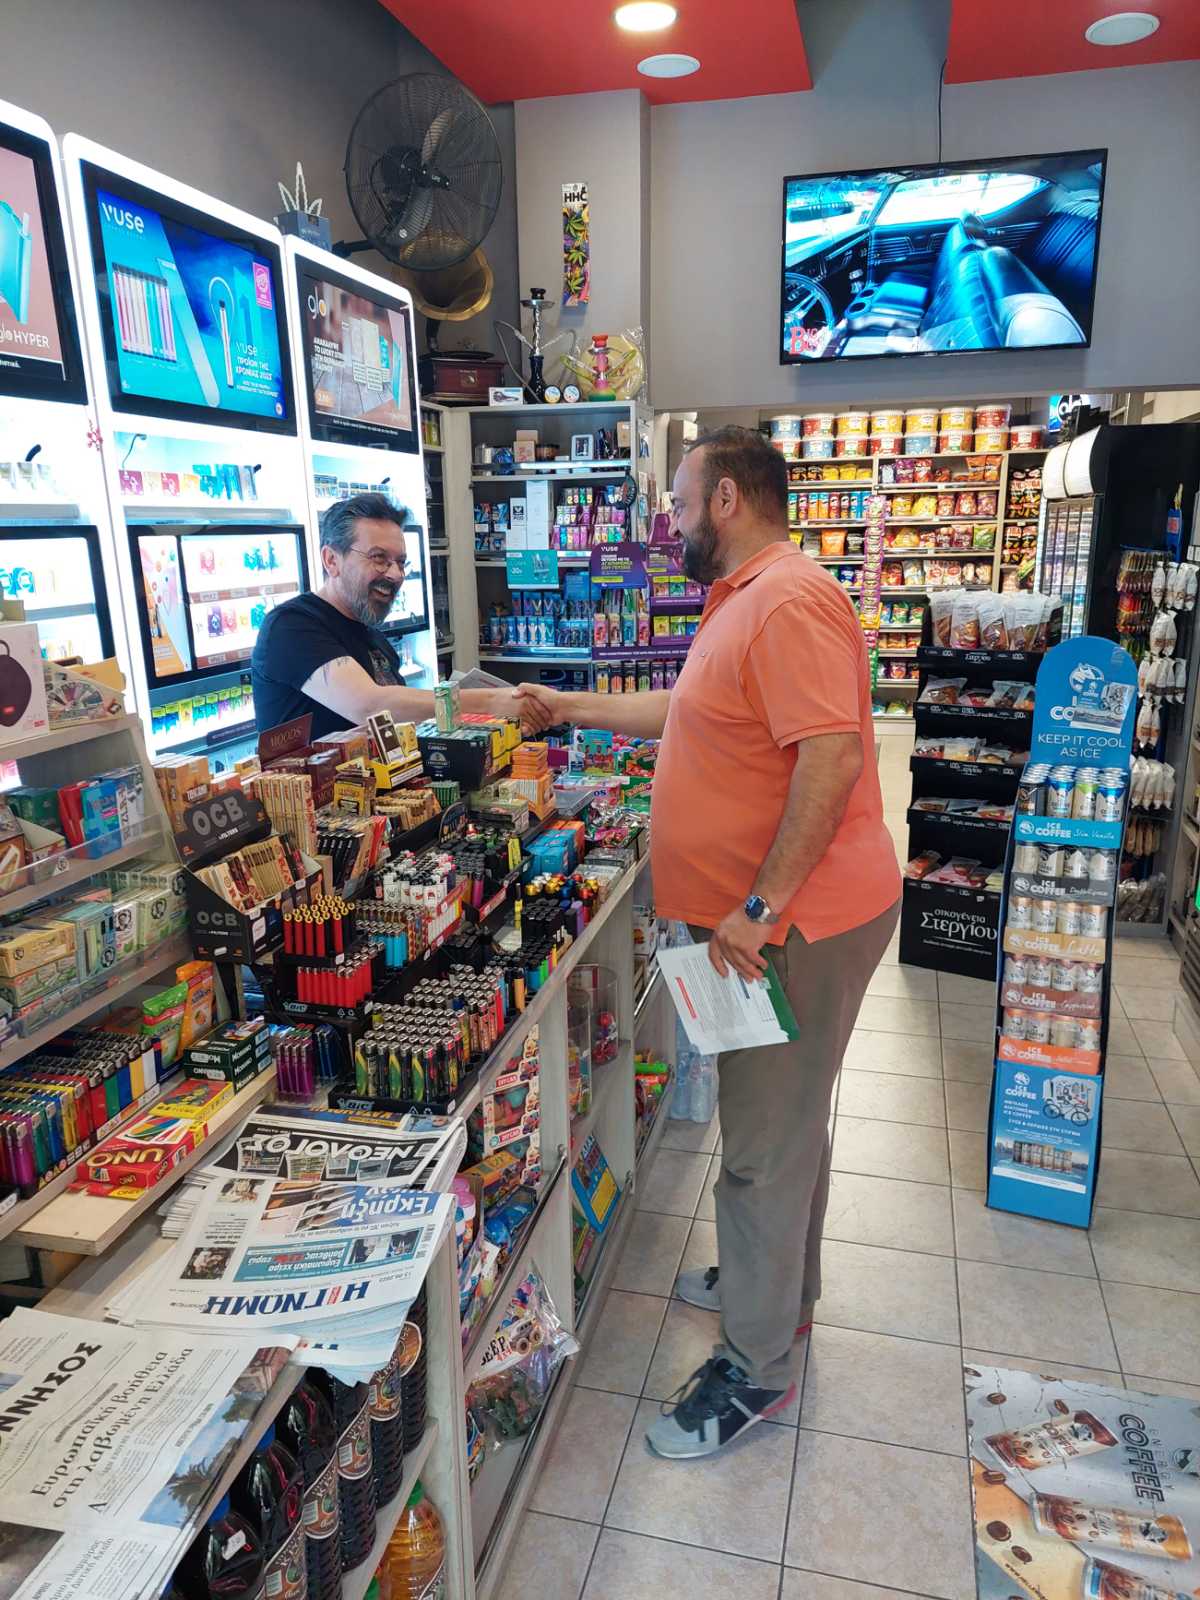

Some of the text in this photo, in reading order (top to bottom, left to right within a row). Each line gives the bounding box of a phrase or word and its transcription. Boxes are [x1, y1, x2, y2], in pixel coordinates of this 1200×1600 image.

[564, 191, 588, 203] HHC
[308, 286, 327, 320] glo
[13, 328, 50, 349] HYPER
[1038, 733, 1127, 748] KEEP IT COOL
[1060, 747, 1102, 759] AS ICE
[192, 797, 245, 836] OCB
[1035, 827, 1072, 838] COFFEE
[1030, 885, 1066, 896] COFFEE
[197, 911, 238, 926] OCB
[934, 908, 986, 924] οικογένεια
[920, 911, 998, 940] Στεργίου
[1023, 940, 1061, 954] COFFEE
[1035, 935, 1049, 944] ICE
[1021, 996, 1057, 1008] COFFEE
[1032, 992, 1046, 1000] ICE
[1016, 1051, 1053, 1063] COFFEE
[1005, 1088, 1037, 1100] COFFEE
[246, 1132, 416, 1160] ΝΕΟΛΟΓΟΣ
[86, 1147, 164, 1167] UNO
[118, 1173, 136, 1184] UNO
[201, 1280, 370, 1316] Η ΓΝΩΜΗ
[0, 1342, 102, 1446] ΝΝΗΣΟΣ
[31, 1405, 117, 1497] Ευρωπαϊκή
[111, 1351, 168, 1404] βοήθεια
[53, 1477, 85, 1508] στη
[77, 1396, 152, 1473] λαβωμένη
[144, 1347, 193, 1395] Ελλάδα
[1119, 1413, 1165, 1502] COFFEE
